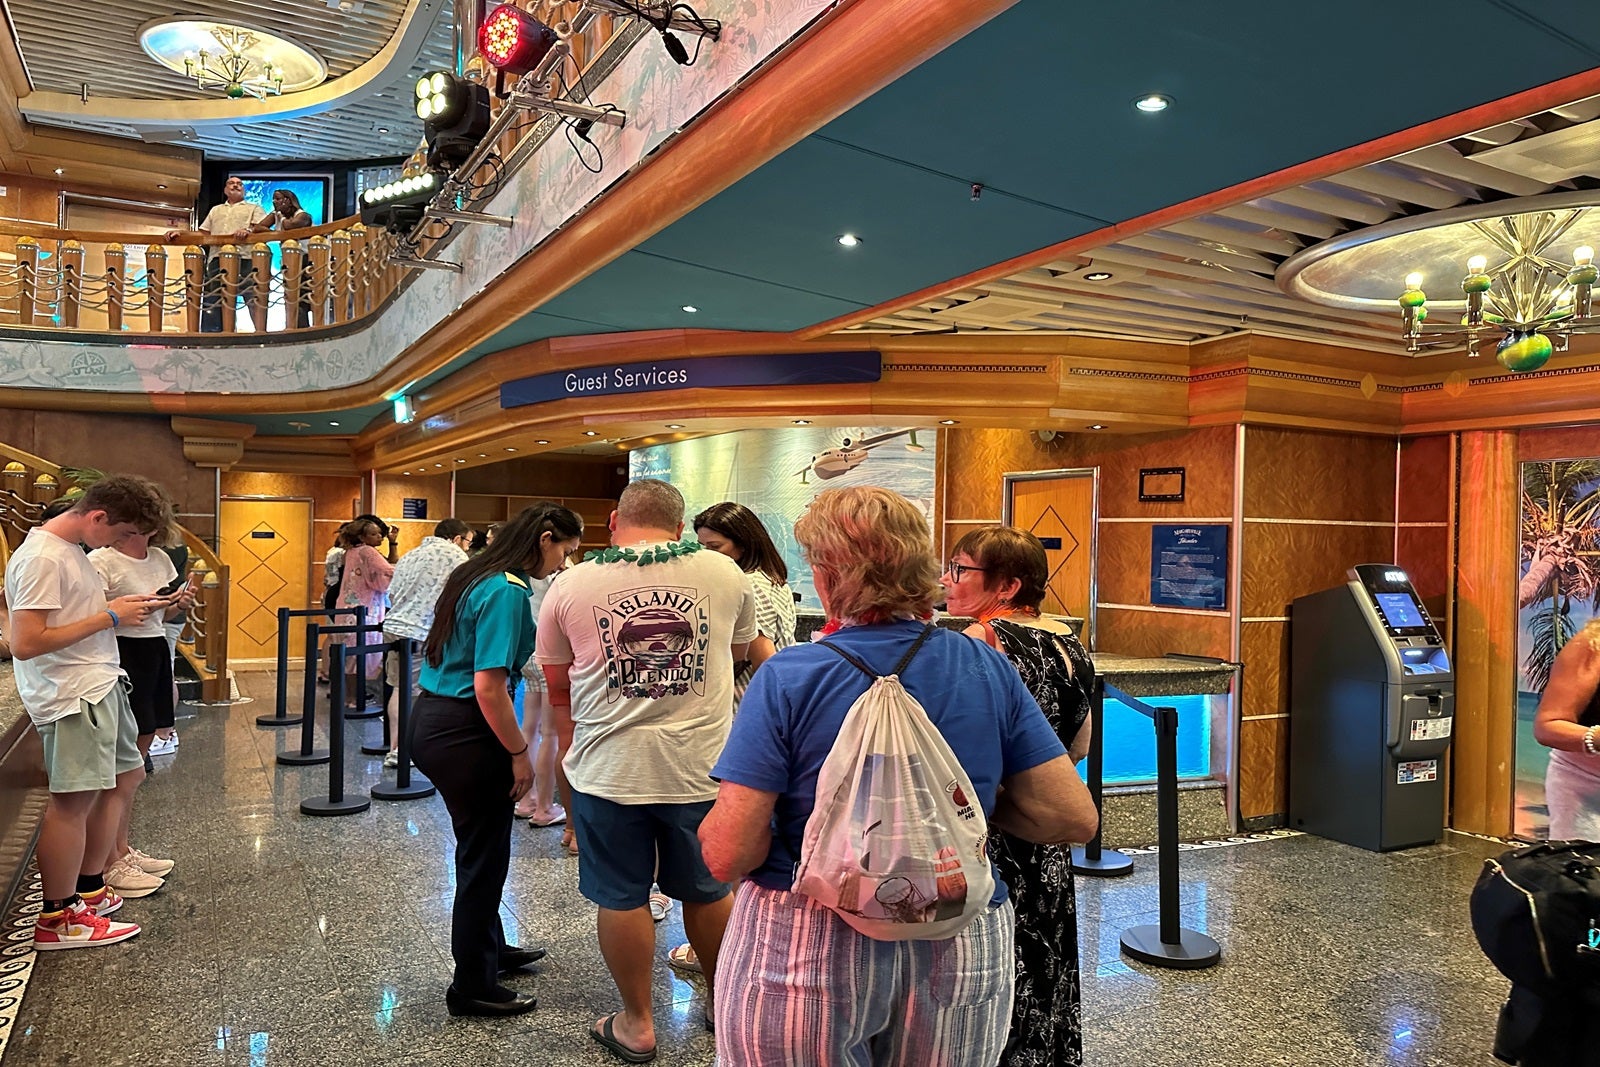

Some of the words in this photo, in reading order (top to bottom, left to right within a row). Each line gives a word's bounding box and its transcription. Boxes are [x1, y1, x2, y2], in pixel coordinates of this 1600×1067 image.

[565, 373, 608, 392] Guest
[614, 366, 687, 388] Services
[612, 591, 694, 619] ISLAND
[599, 617, 619, 688] OCEAN
[695, 608, 708, 682] LOVER
[957, 805, 974, 816] MIA
